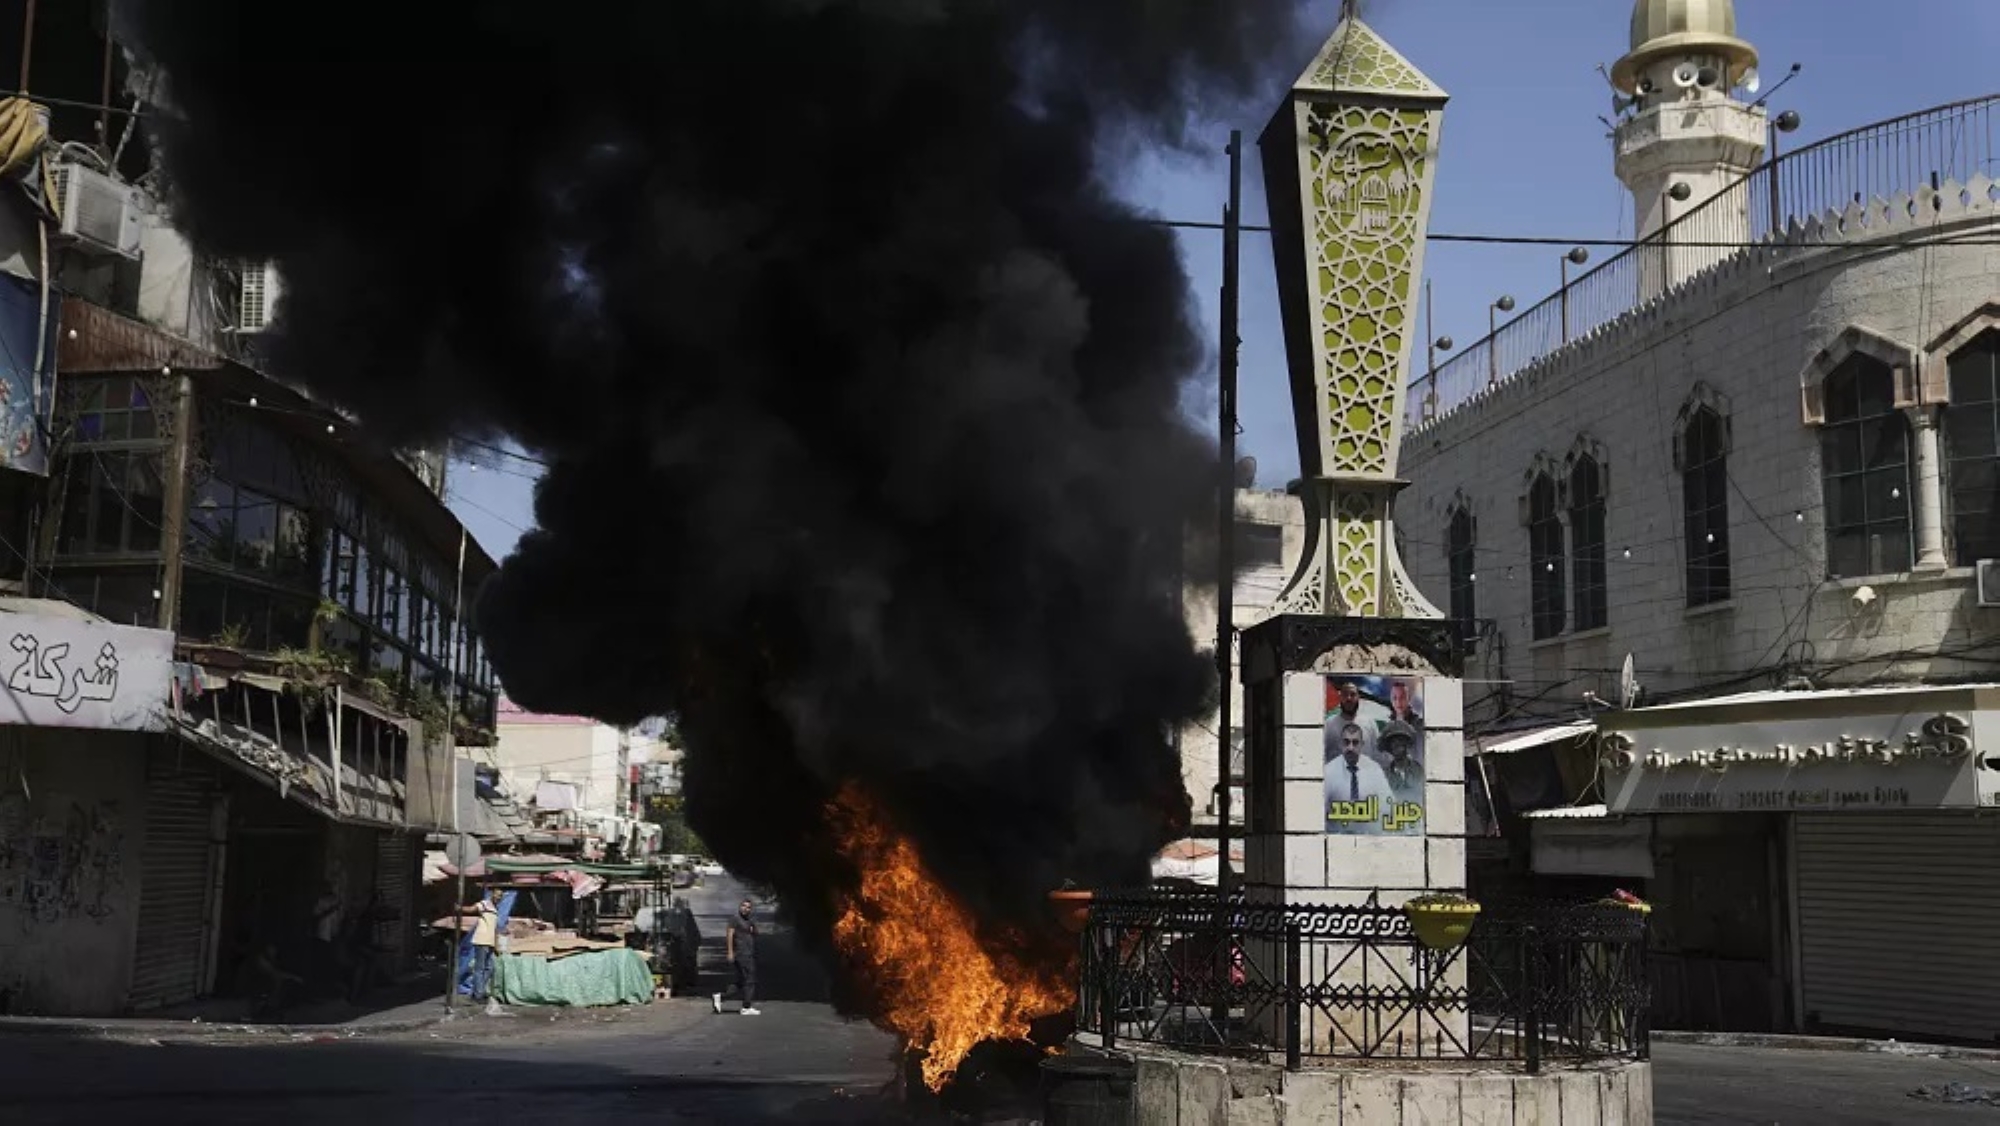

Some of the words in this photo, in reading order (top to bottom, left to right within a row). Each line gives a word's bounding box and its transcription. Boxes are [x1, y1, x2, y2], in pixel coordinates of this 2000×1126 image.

[8, 633, 119, 714] شركة
[1327, 795, 1379, 826] المجد
[1382, 797, 1423, 831] جنين
